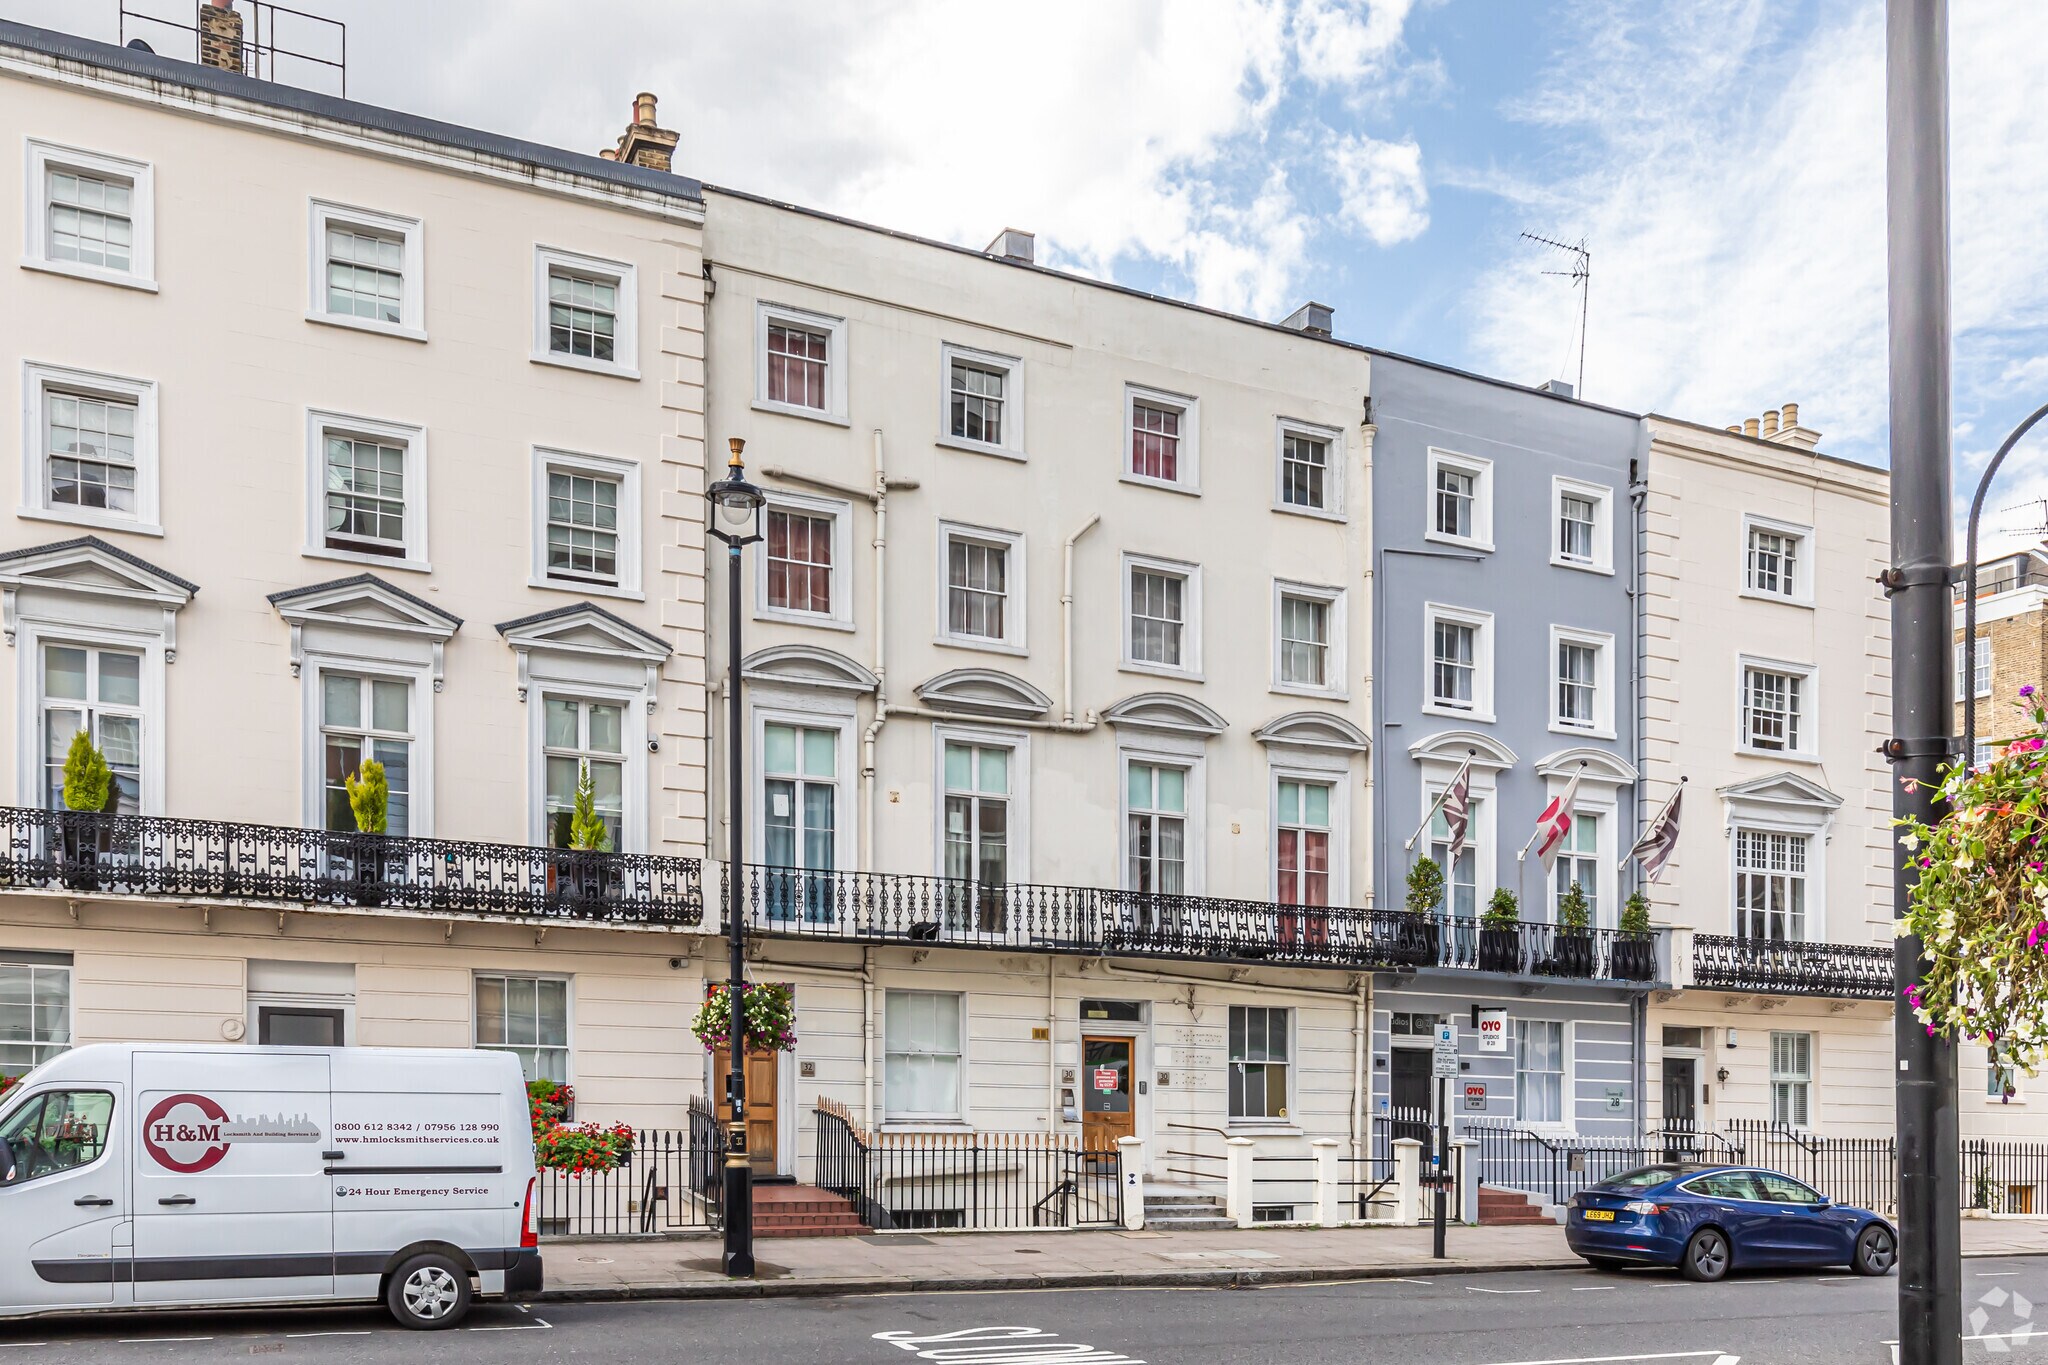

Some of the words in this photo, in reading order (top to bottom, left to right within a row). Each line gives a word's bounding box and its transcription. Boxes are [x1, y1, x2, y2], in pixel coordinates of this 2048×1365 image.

[1481, 1020, 1501, 1031] OYO
[1467, 1087, 1484, 1095] OYO
[1611, 1098, 1620, 1106] 28
[334, 1123, 360, 1131] 0800
[364, 1123, 383, 1131] 612
[387, 1123, 412, 1131] 8342
[416, 1123, 420, 1132] /
[424, 1123, 456, 1131] 07956
[460, 1123, 478, 1131] 128
[481, 1123, 499, 1131] 990
[154, 1124, 220, 1142] H&M
[394, 1188, 449, 1197] Emergency
[452, 1187, 489, 1195] Service
